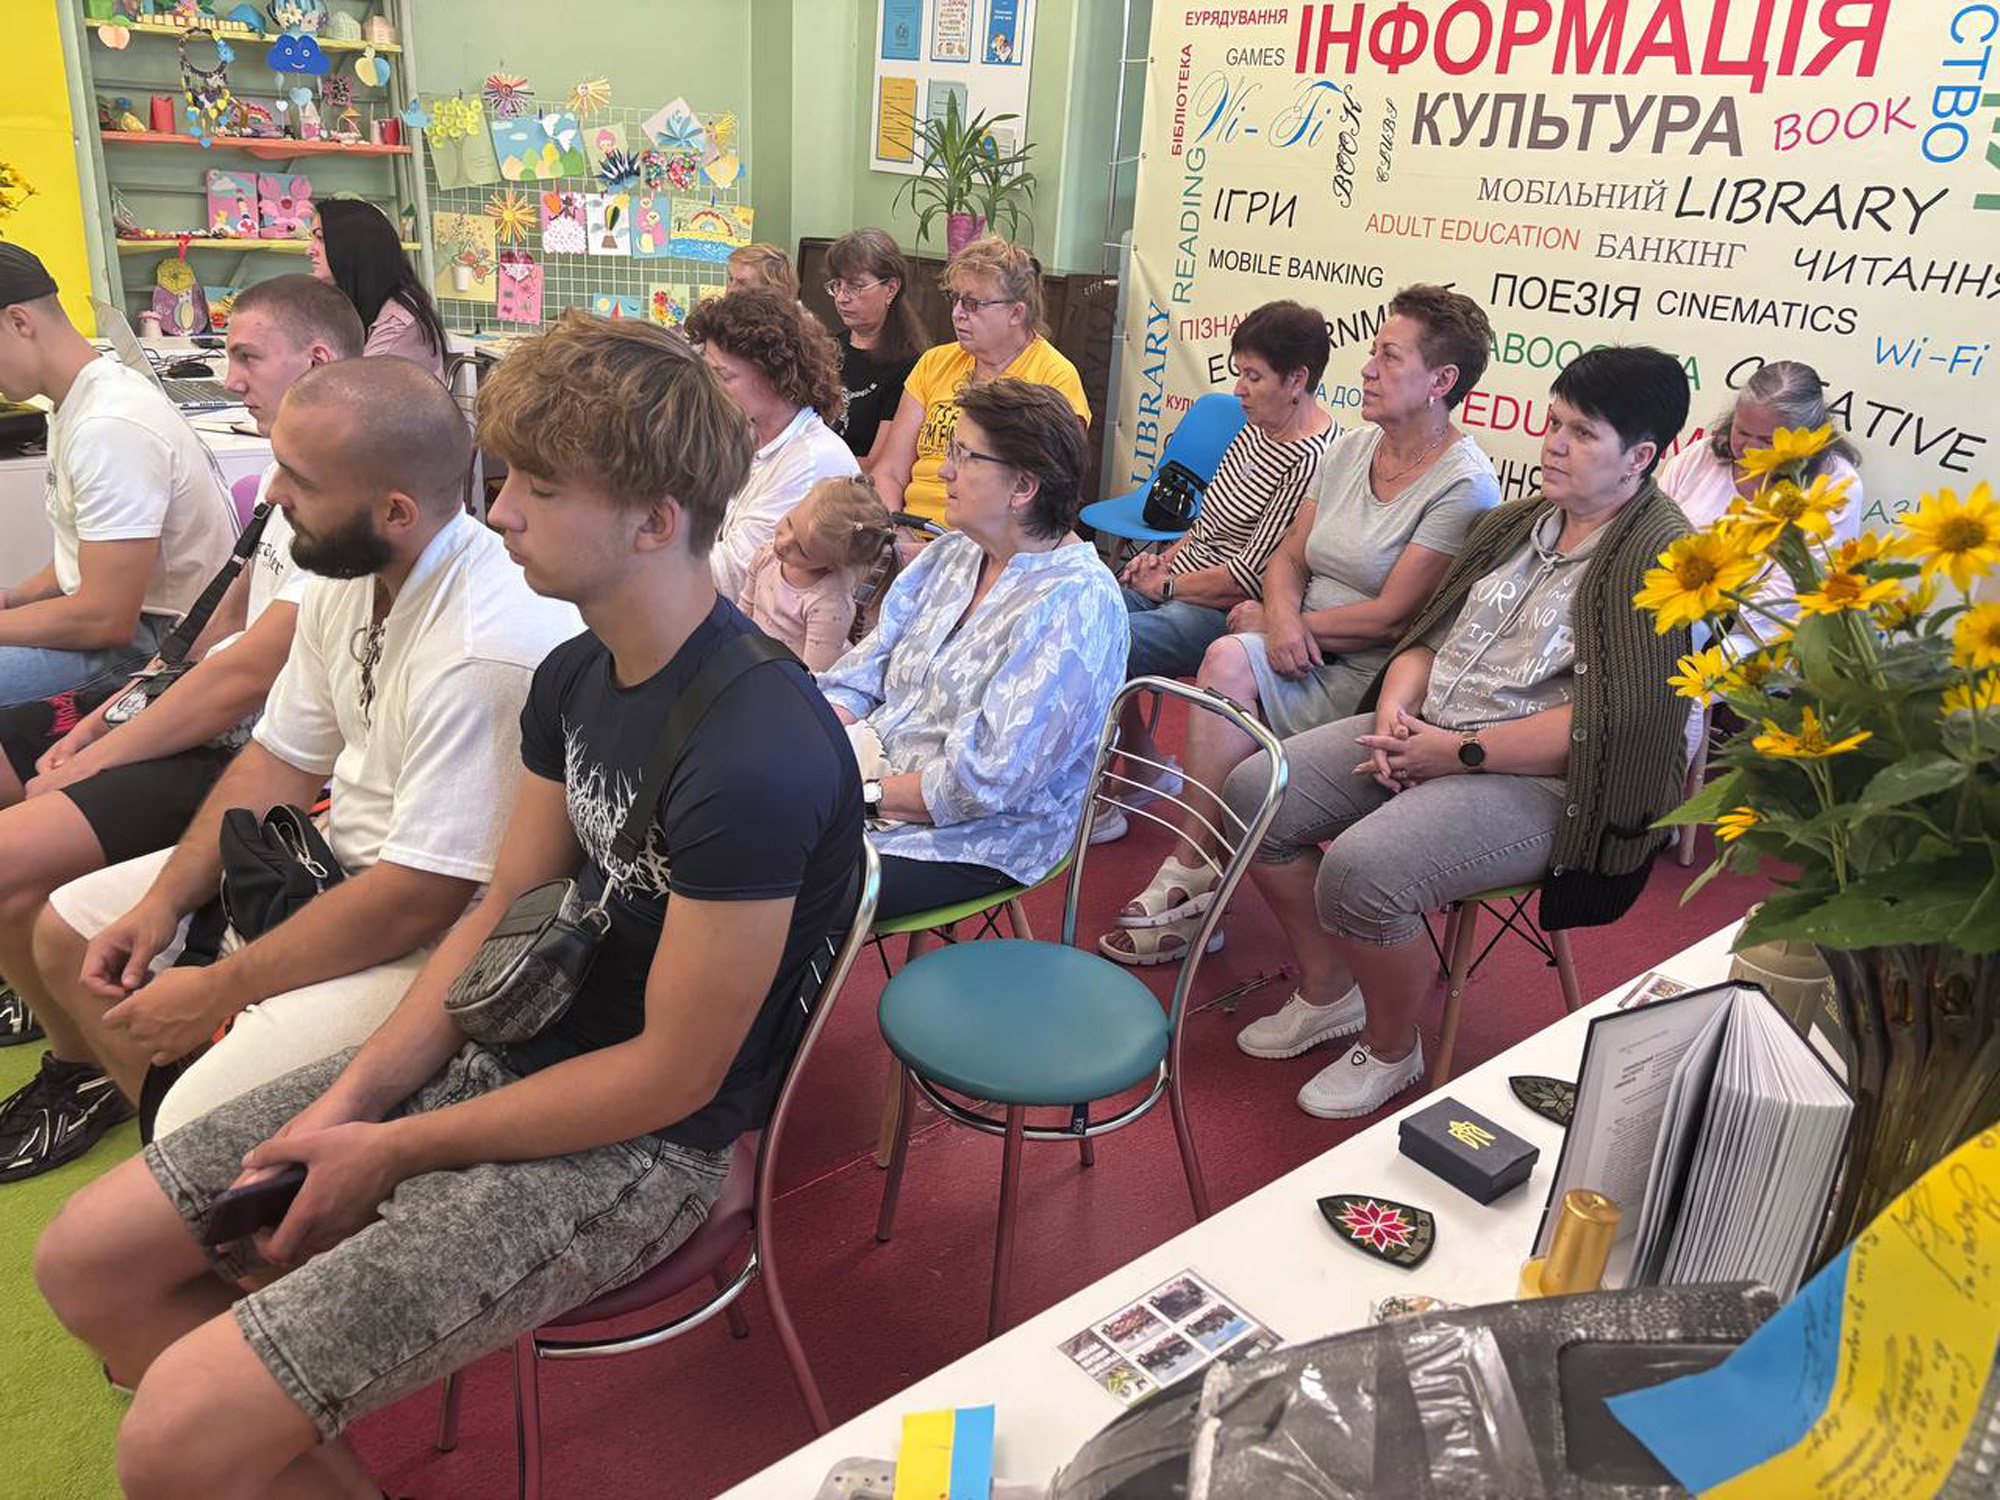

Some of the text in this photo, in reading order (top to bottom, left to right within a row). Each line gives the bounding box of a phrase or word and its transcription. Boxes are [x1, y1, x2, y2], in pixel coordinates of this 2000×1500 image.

[1185, 9, 1288, 29] ЕУРЯДУВАННЯ
[1226, 48, 1286, 66] GAMES
[1295, 0, 1892, 93] ІНФОРМАЦІЯ
[1172, 44, 1193, 156] БІБЛІОТЕКА
[1774, 96, 1917, 151] BOOK
[1332, 83, 1365, 208] BOOK
[1412, 92, 1743, 157] КУЛЬТУРА
[1213, 188, 1297, 228] ІГРИ
[1477, 177, 1668, 213] МОБІЛЬНИЙ
[1674, 176, 1950, 236] LIBRARY
[1173, 147, 1206, 303] READING
[1365, 213, 1580, 251] ADULT EDUCATION
[1208, 249, 1384, 288] MOBILE BANKING
[1595, 233, 1747, 270] БАНКІНГ
[1491, 273, 1641, 321] ПОЕЗІЯ
[1656, 289, 1858, 335] CINEMATICS
[1875, 336, 1990, 375] Wi-Fi
[1725, 356, 1988, 473] CATIVE
